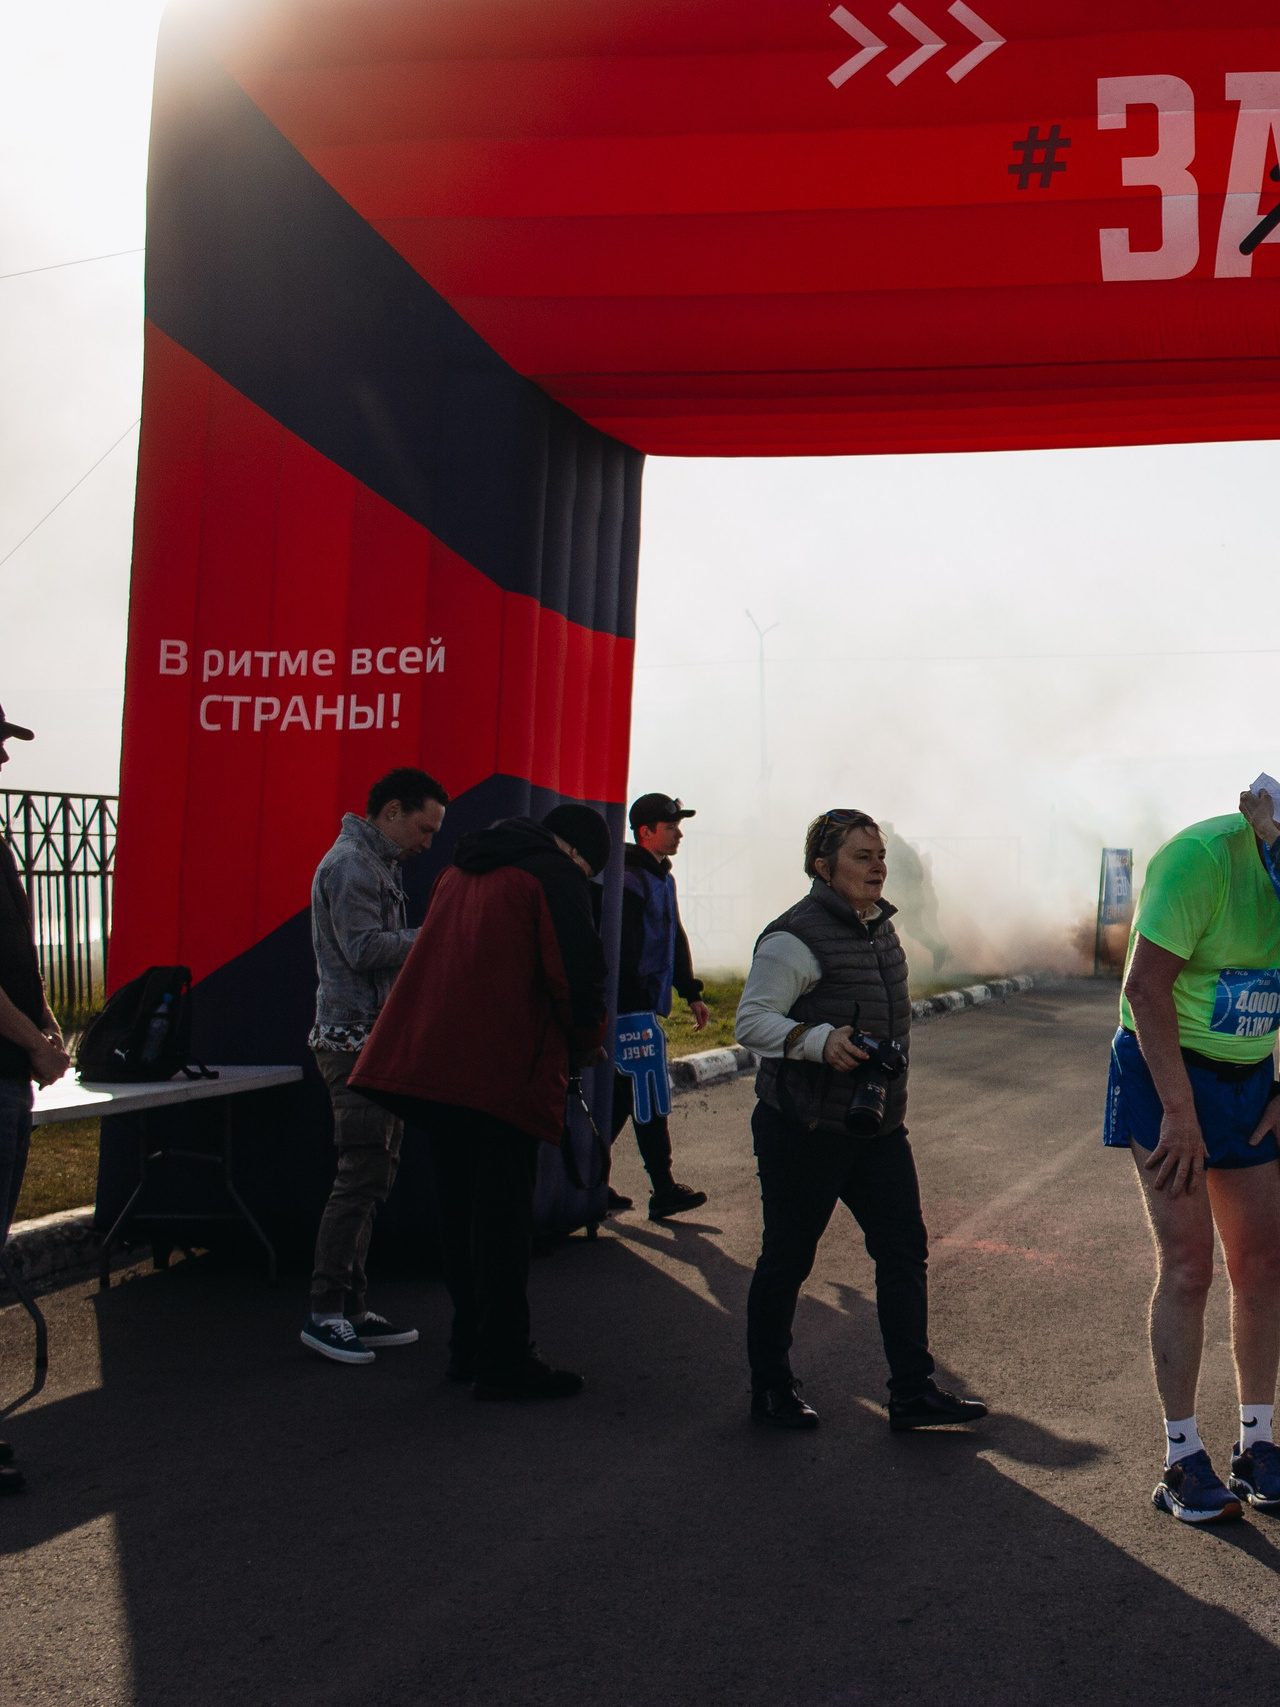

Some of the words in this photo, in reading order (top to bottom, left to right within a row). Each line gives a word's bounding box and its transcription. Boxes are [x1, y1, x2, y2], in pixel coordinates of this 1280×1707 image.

[159, 639, 188, 676] В
[203, 649, 335, 682] ритме
[351, 637, 445, 676] всей
[200, 693, 401, 731] СТРАНЫ!
